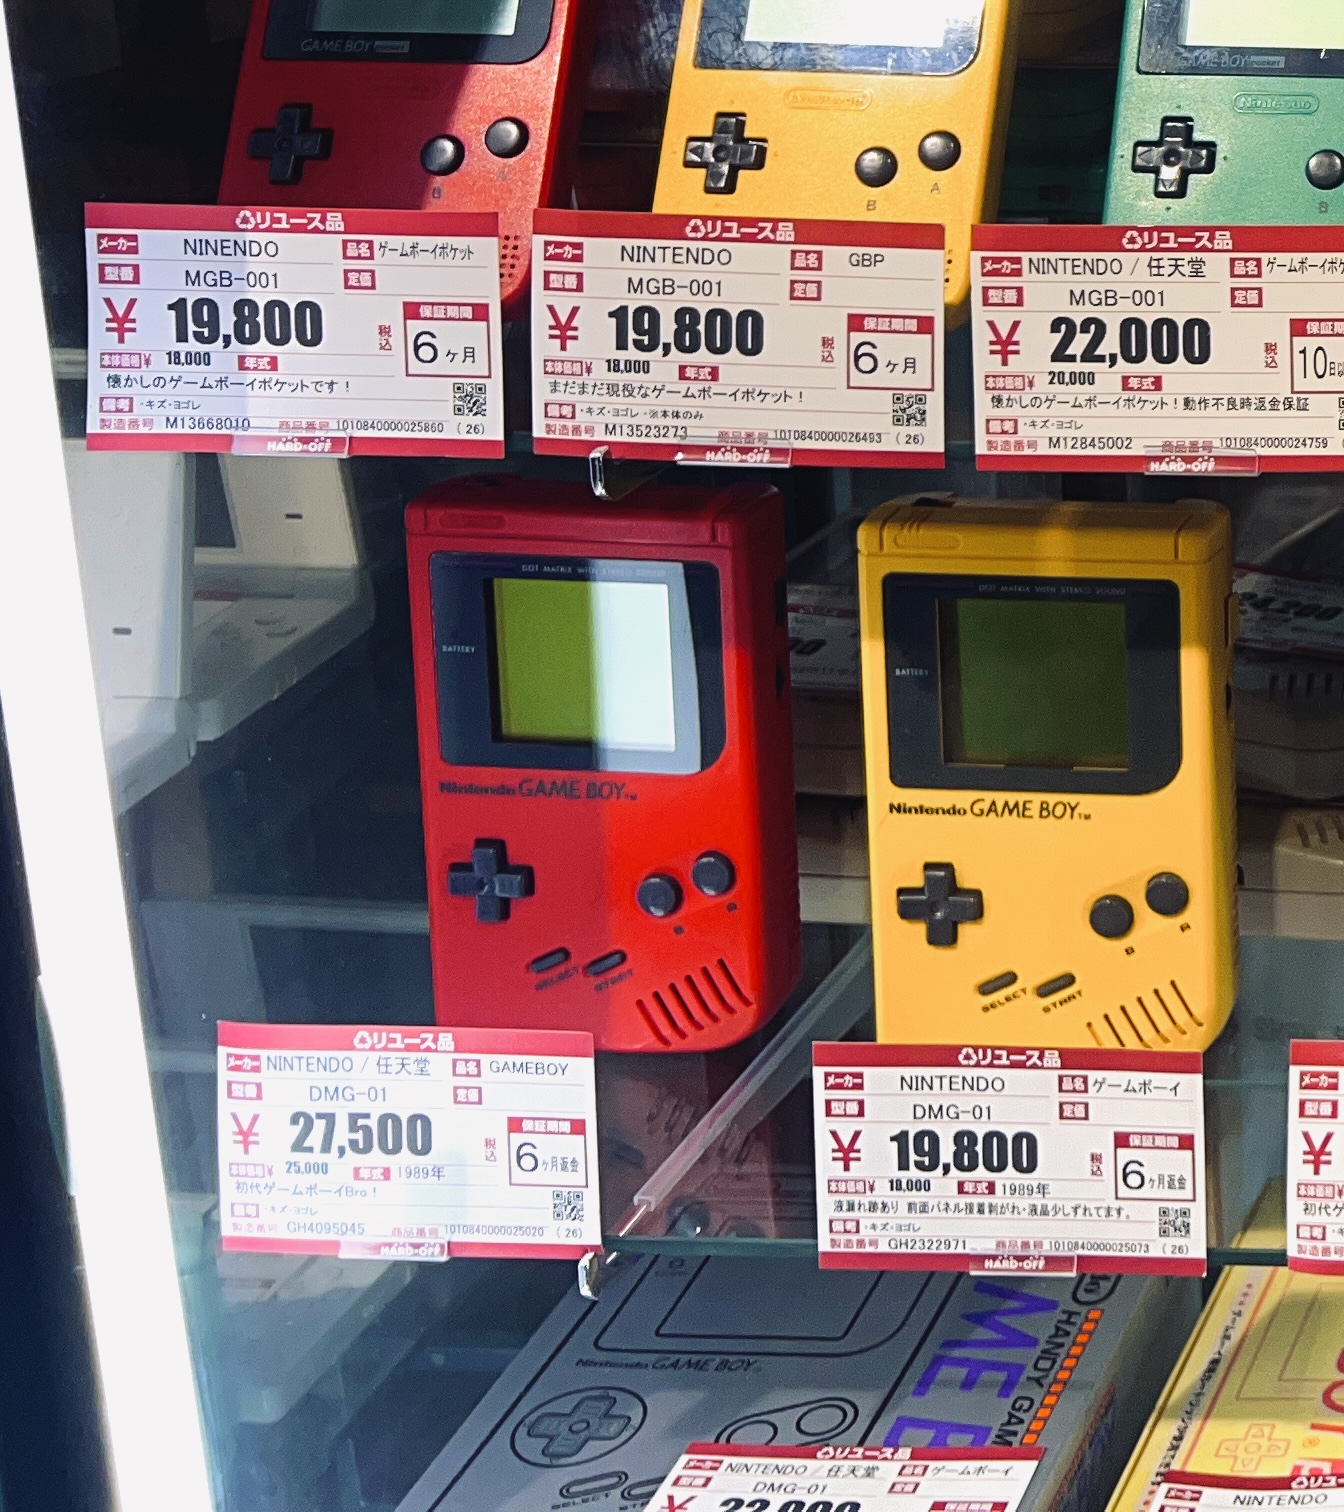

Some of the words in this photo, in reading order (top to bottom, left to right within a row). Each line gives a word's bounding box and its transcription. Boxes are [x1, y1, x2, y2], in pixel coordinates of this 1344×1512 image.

[183, 238, 279, 258] NINENDO
[620, 244, 733, 266] NINTENDO
[848, 252, 885, 268] GBP
[1027, 257, 1123, 276] NINTENDO
[1146, 255, 1207, 278] 任天堂
[184, 270, 279, 289] MGB-001
[627, 276, 723, 297] MGB-001
[1068, 290, 1166, 308] MGB-001
[166, 297, 323, 349] 19,800
[607, 304, 765, 357] 19,800
[1049, 316, 1211, 369] 22,000
[1047, 436, 1133, 451] M12845002
[888, 801, 967, 818] Nintendo
[970, 797, 1035, 819] GAME
[1036, 799, 1080, 822] BOY
[266, 1055, 354, 1074] NINTENDO
[489, 1061, 569, 1076] GAMEBOY
[899, 1075, 1006, 1093] NINTENDO
[309, 1086, 388, 1103] DMG-01
[912, 1104, 992, 1121] DMG-01
[289, 1111, 432, 1160] 27,500
[889, 1129, 1038, 1178] 19,800
[1024, 1309, 1081, 1389] HANDY
[723, 1461, 810, 1478] NINTENDO
[752, 1481, 829, 1495] DMG-01
